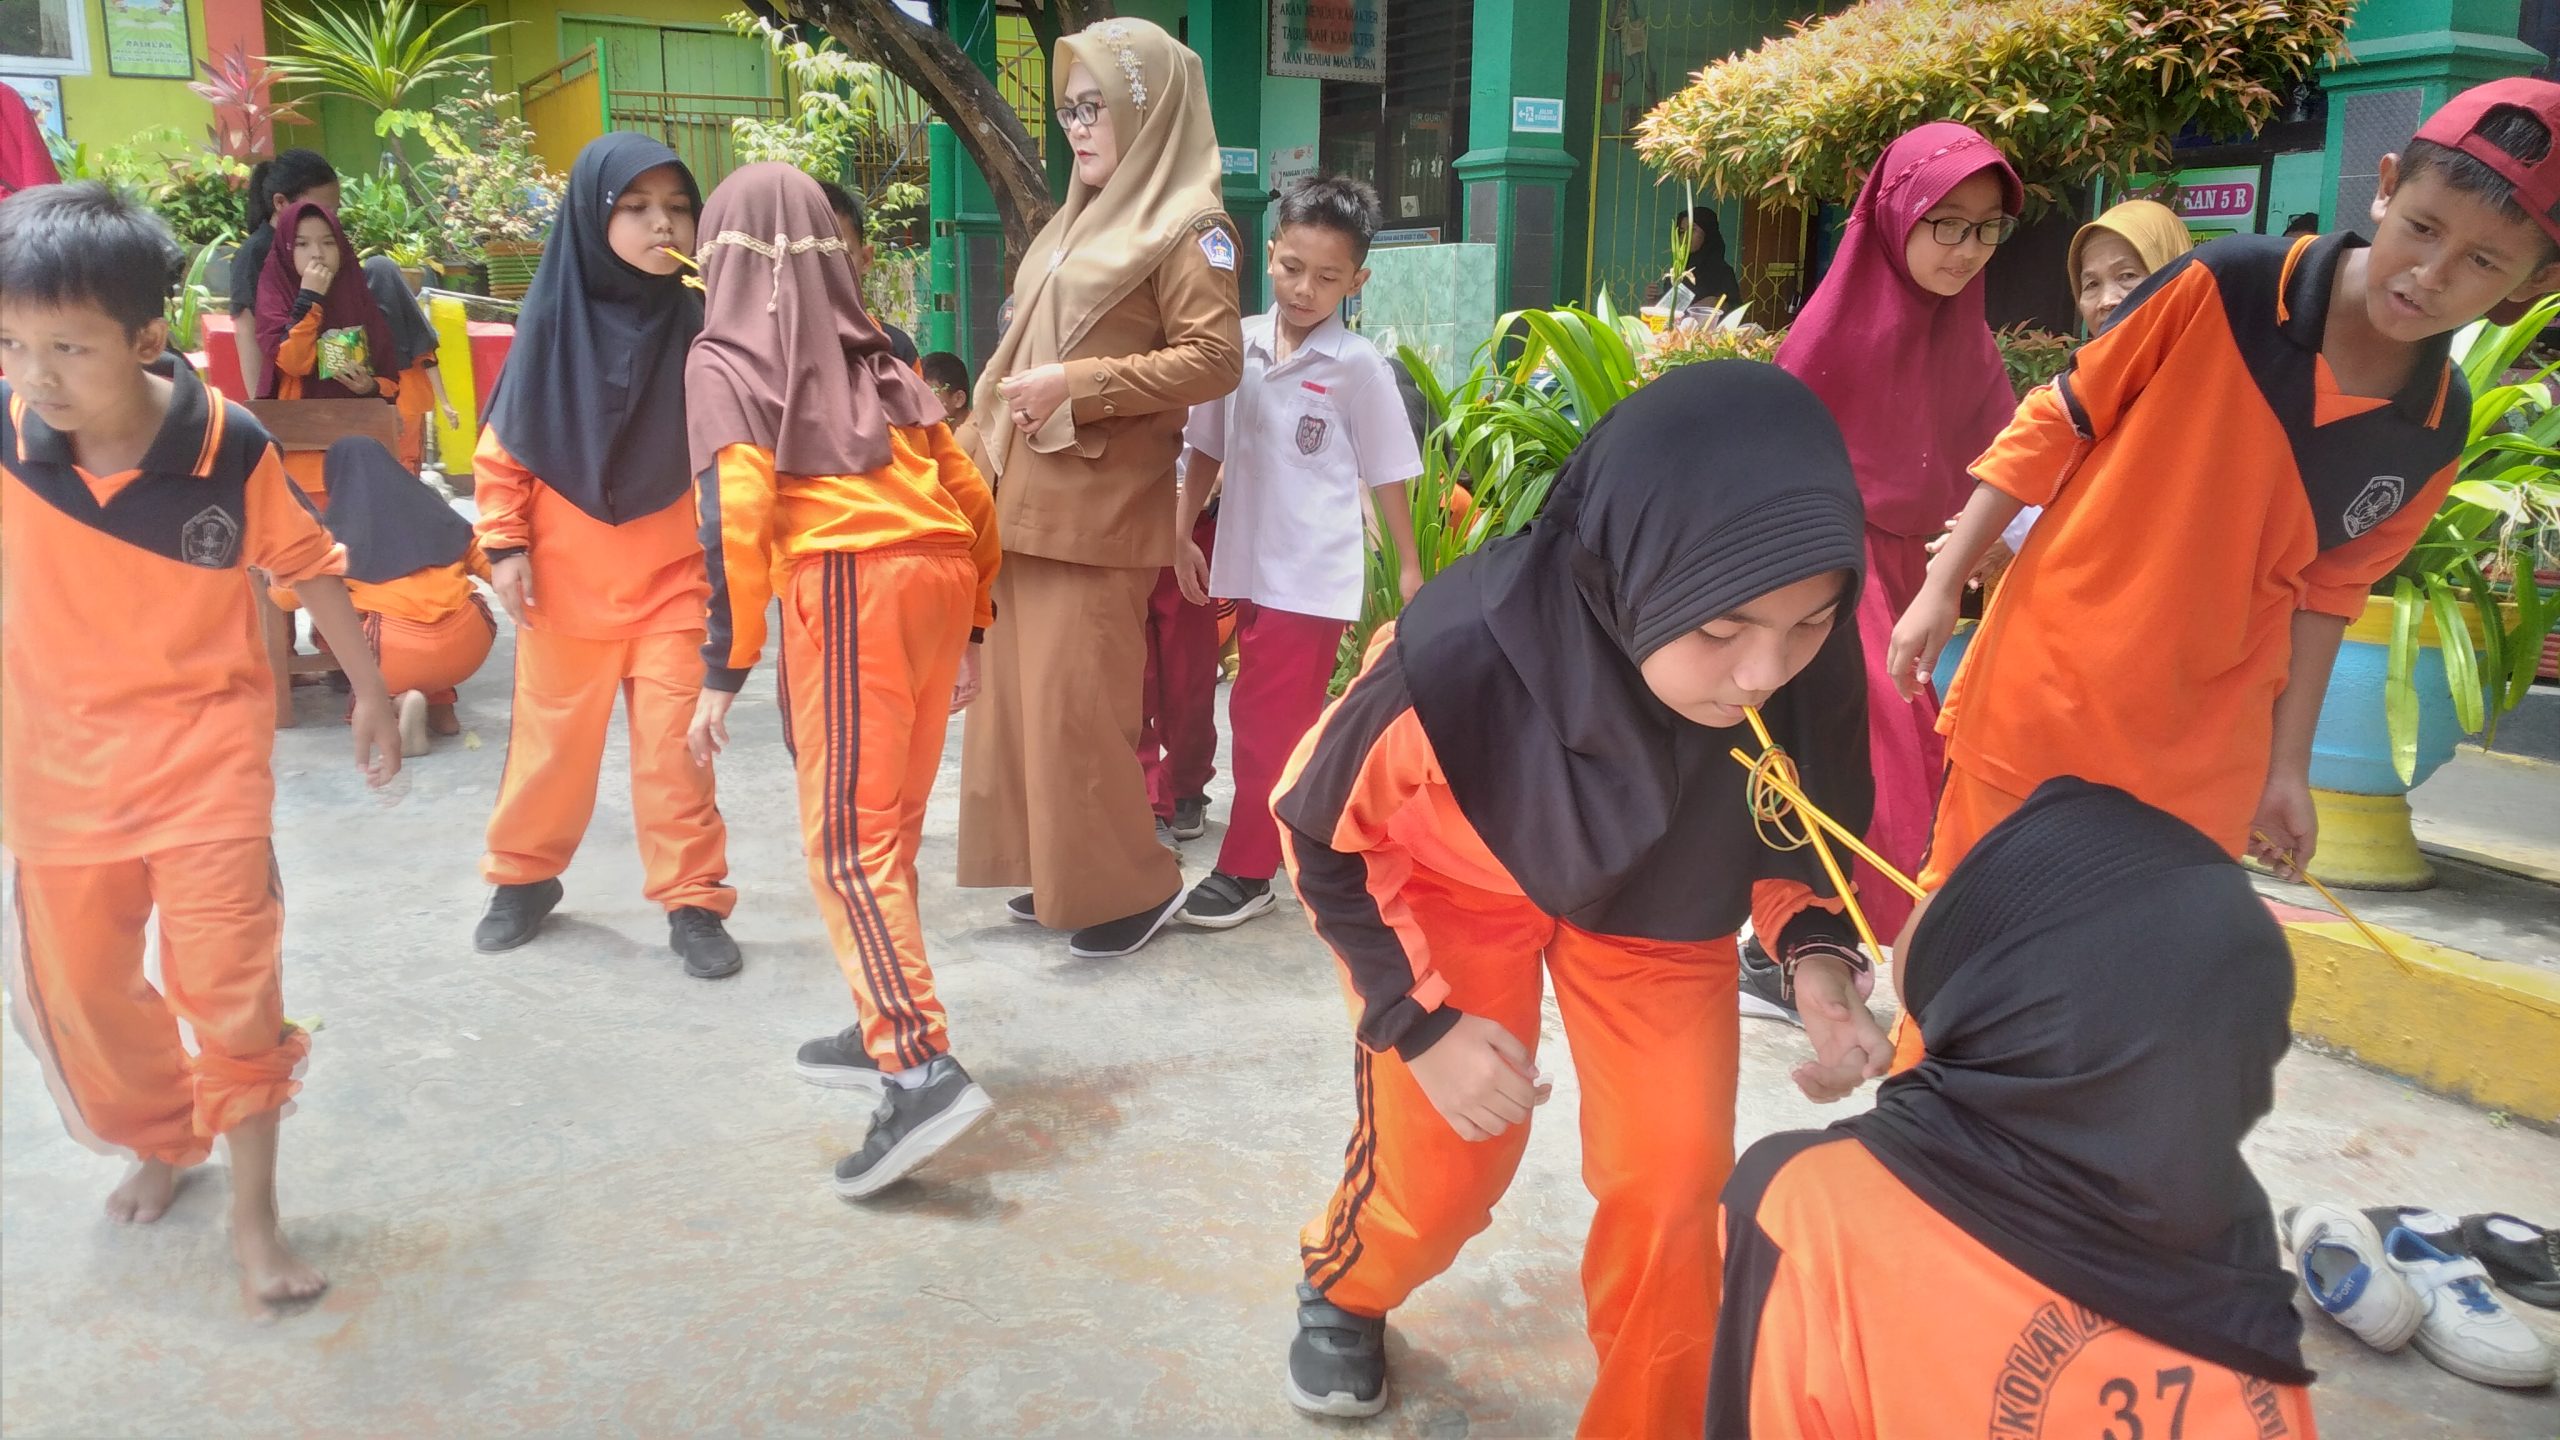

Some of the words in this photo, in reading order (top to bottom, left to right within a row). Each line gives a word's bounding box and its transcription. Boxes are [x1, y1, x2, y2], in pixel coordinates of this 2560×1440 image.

[1280, 3, 1301, 16] AKAN
[1338, 8, 1378, 24] KARAKTER
[1331, 31, 1375, 48] KARAKTER
[1282, 52, 1301, 64] AKAN
[1304, 53, 1331, 66] MENUAI
[1333, 55, 1352, 69] MASA
[1354, 56, 1376, 70] DEPAN
[2221, 190, 2230, 209] 5
[2234, 188, 2246, 208] R
[1995, 1306, 2082, 1440] KOLAH
[2098, 1366, 2195, 1440] 37
